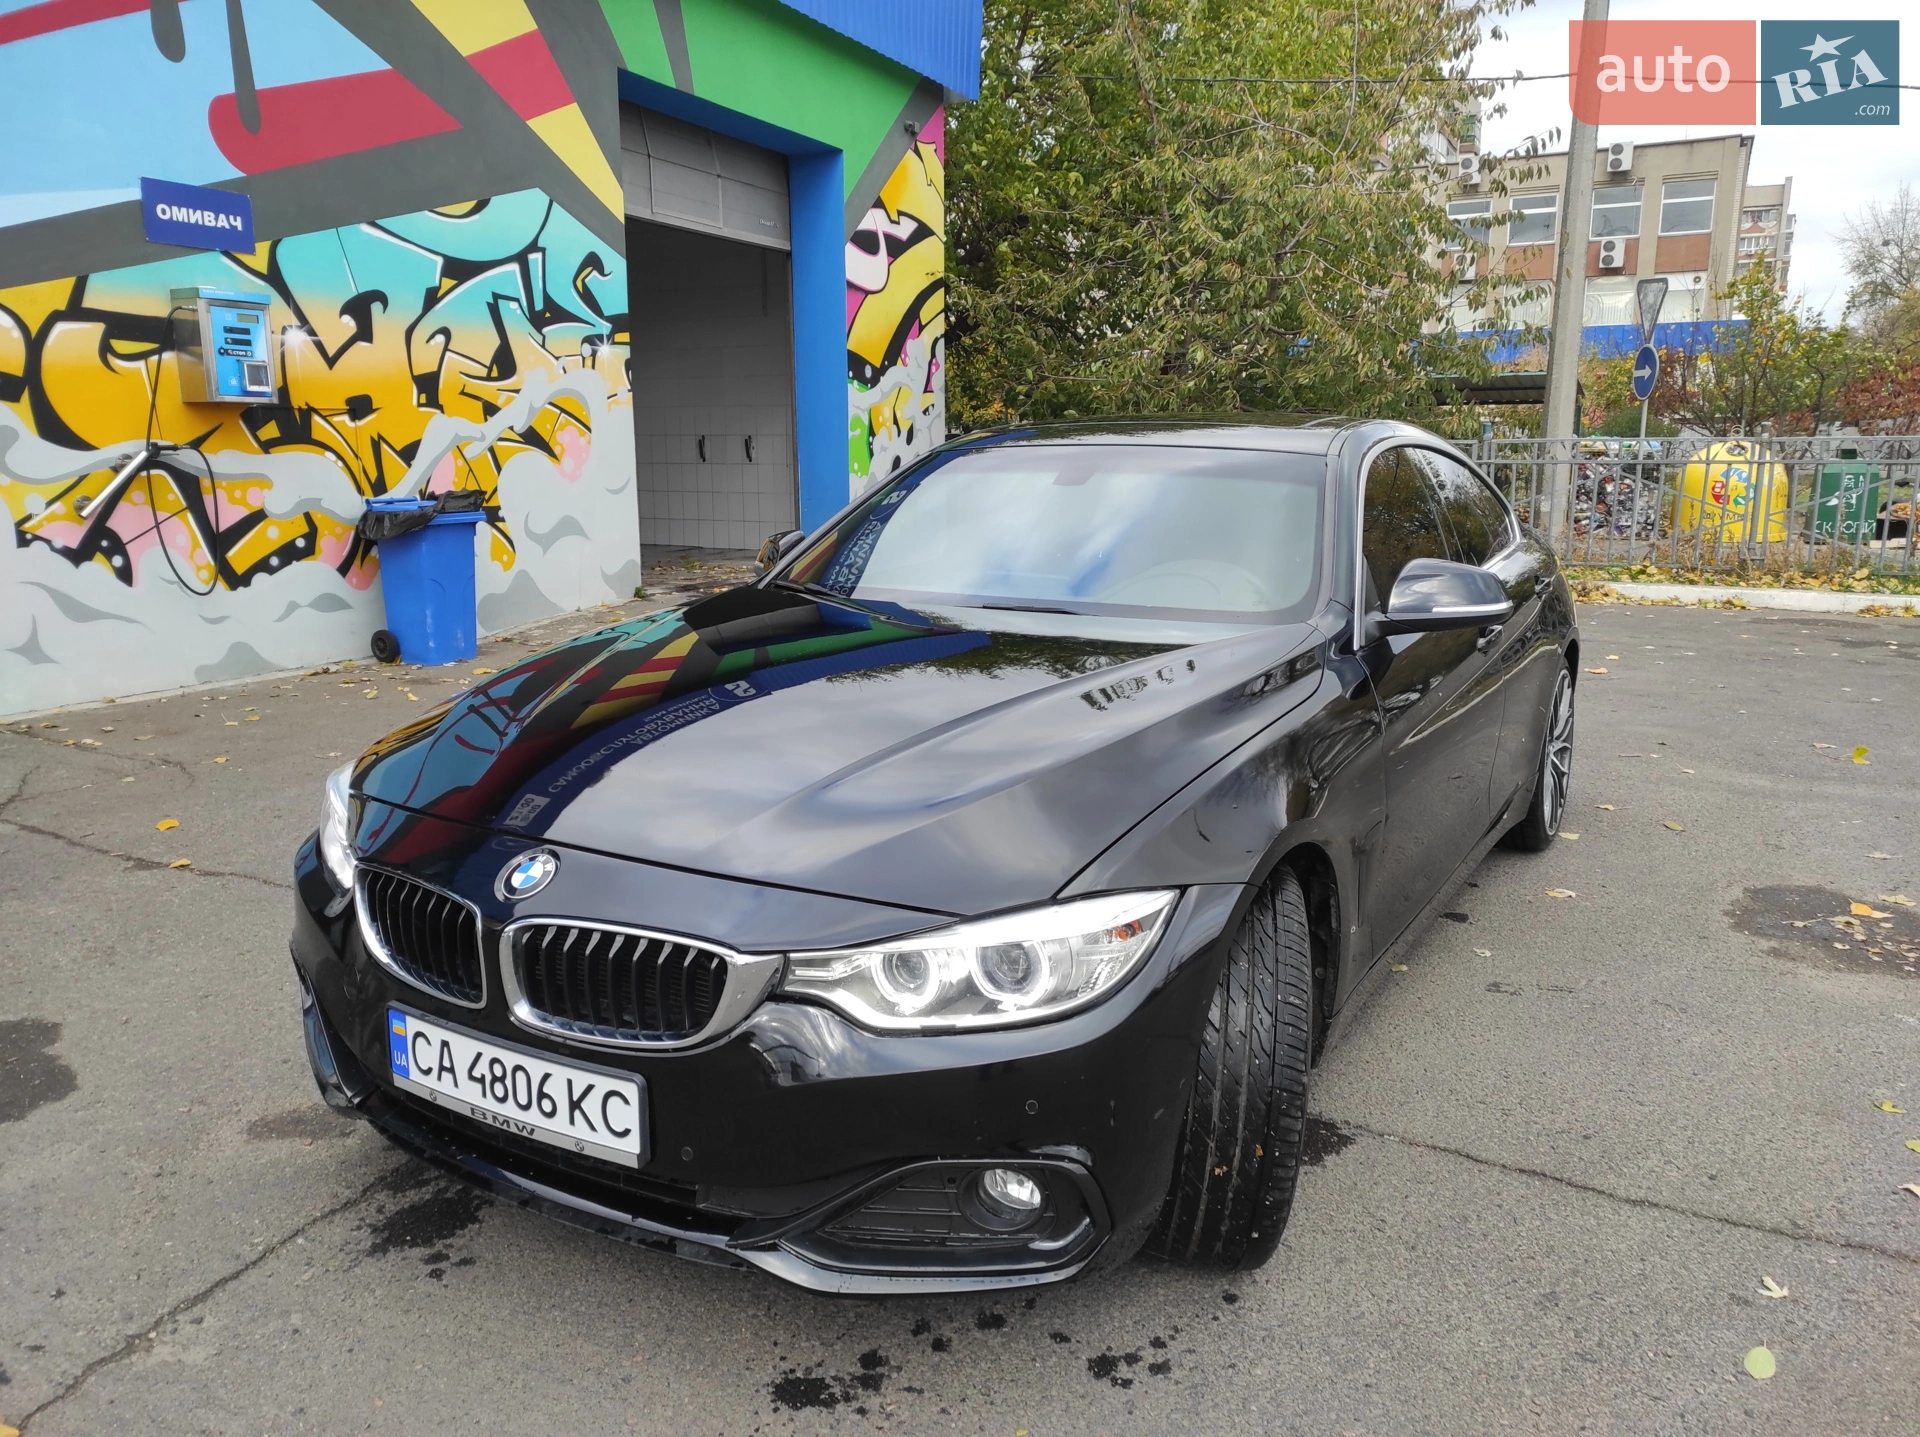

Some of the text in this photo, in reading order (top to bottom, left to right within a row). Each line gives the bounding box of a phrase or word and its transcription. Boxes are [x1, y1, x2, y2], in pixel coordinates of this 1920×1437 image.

[156, 203, 243, 231] ОМИВАЧ
[394, 1049, 408, 1069] UA
[411, 1030, 632, 1139] CA 4806 KC
[470, 1107, 536, 1137] BMW
